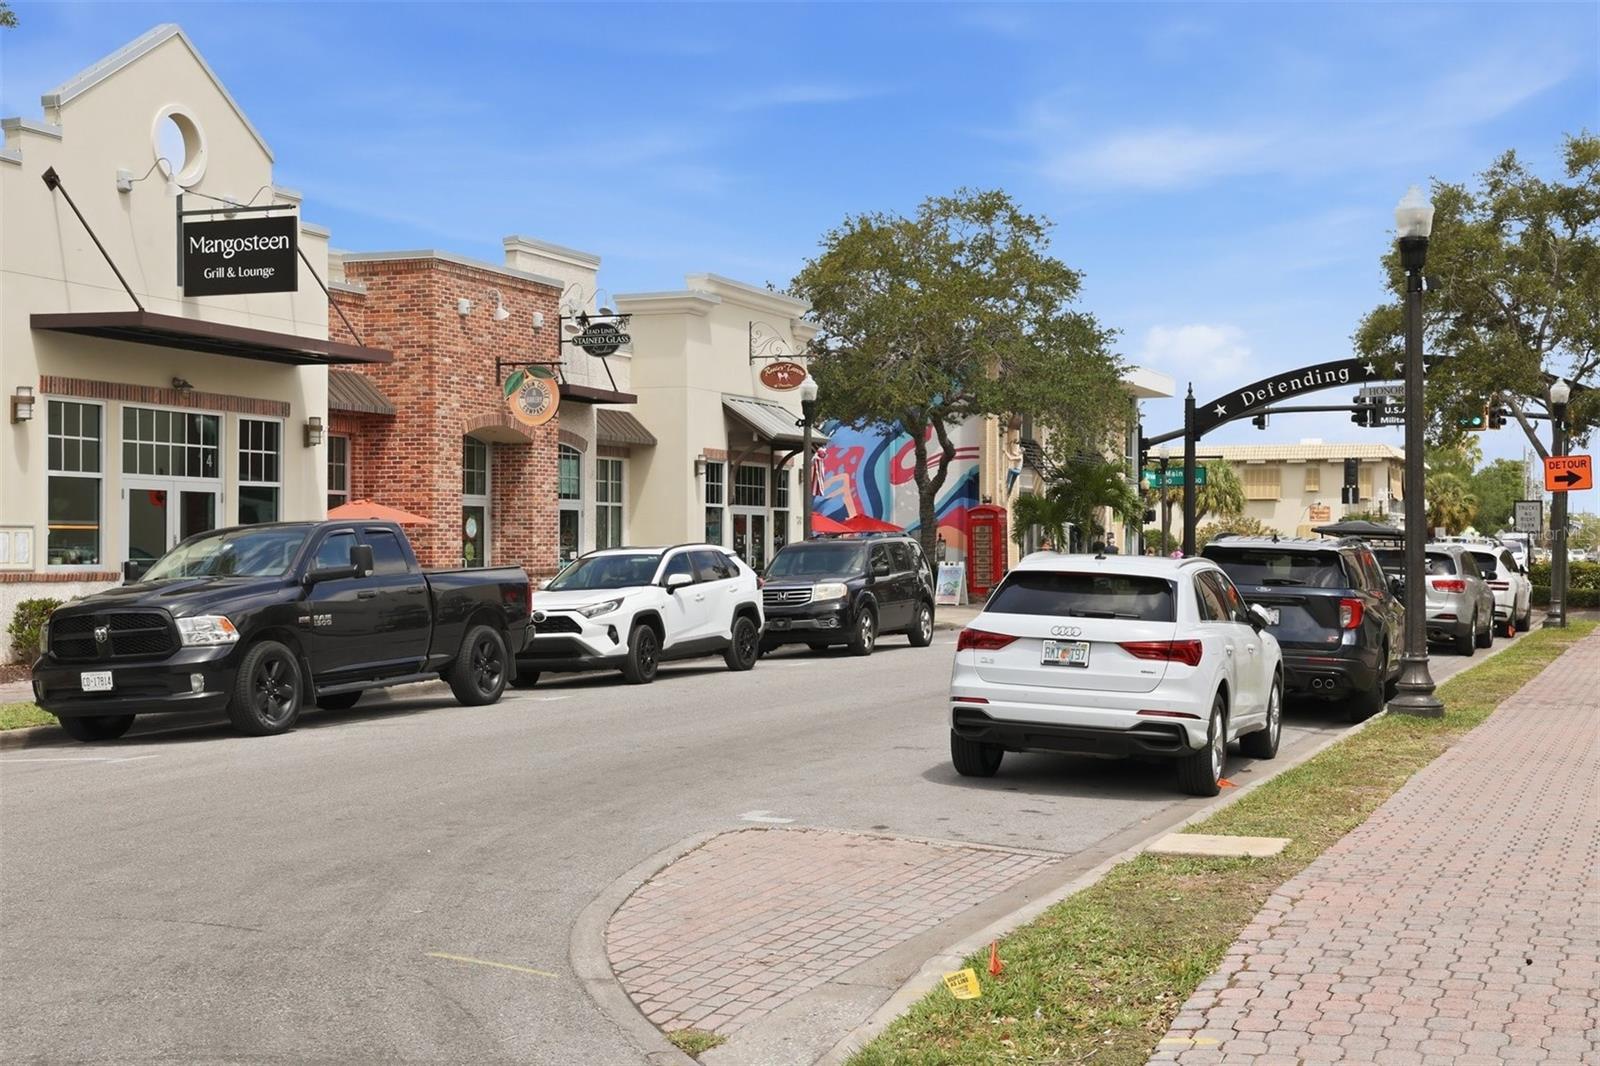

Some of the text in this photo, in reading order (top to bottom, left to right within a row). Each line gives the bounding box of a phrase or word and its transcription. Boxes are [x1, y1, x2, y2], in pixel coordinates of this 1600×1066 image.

[190, 235, 290, 259] Mangosteen
[203, 266, 275, 279] Grill & Lounge
[573, 334, 629, 345] STAINED GLASS
[1240, 368, 1350, 406] Defending
[1369, 386, 1405, 396] HONOR
[1548, 460, 1587, 470] DETOUR
